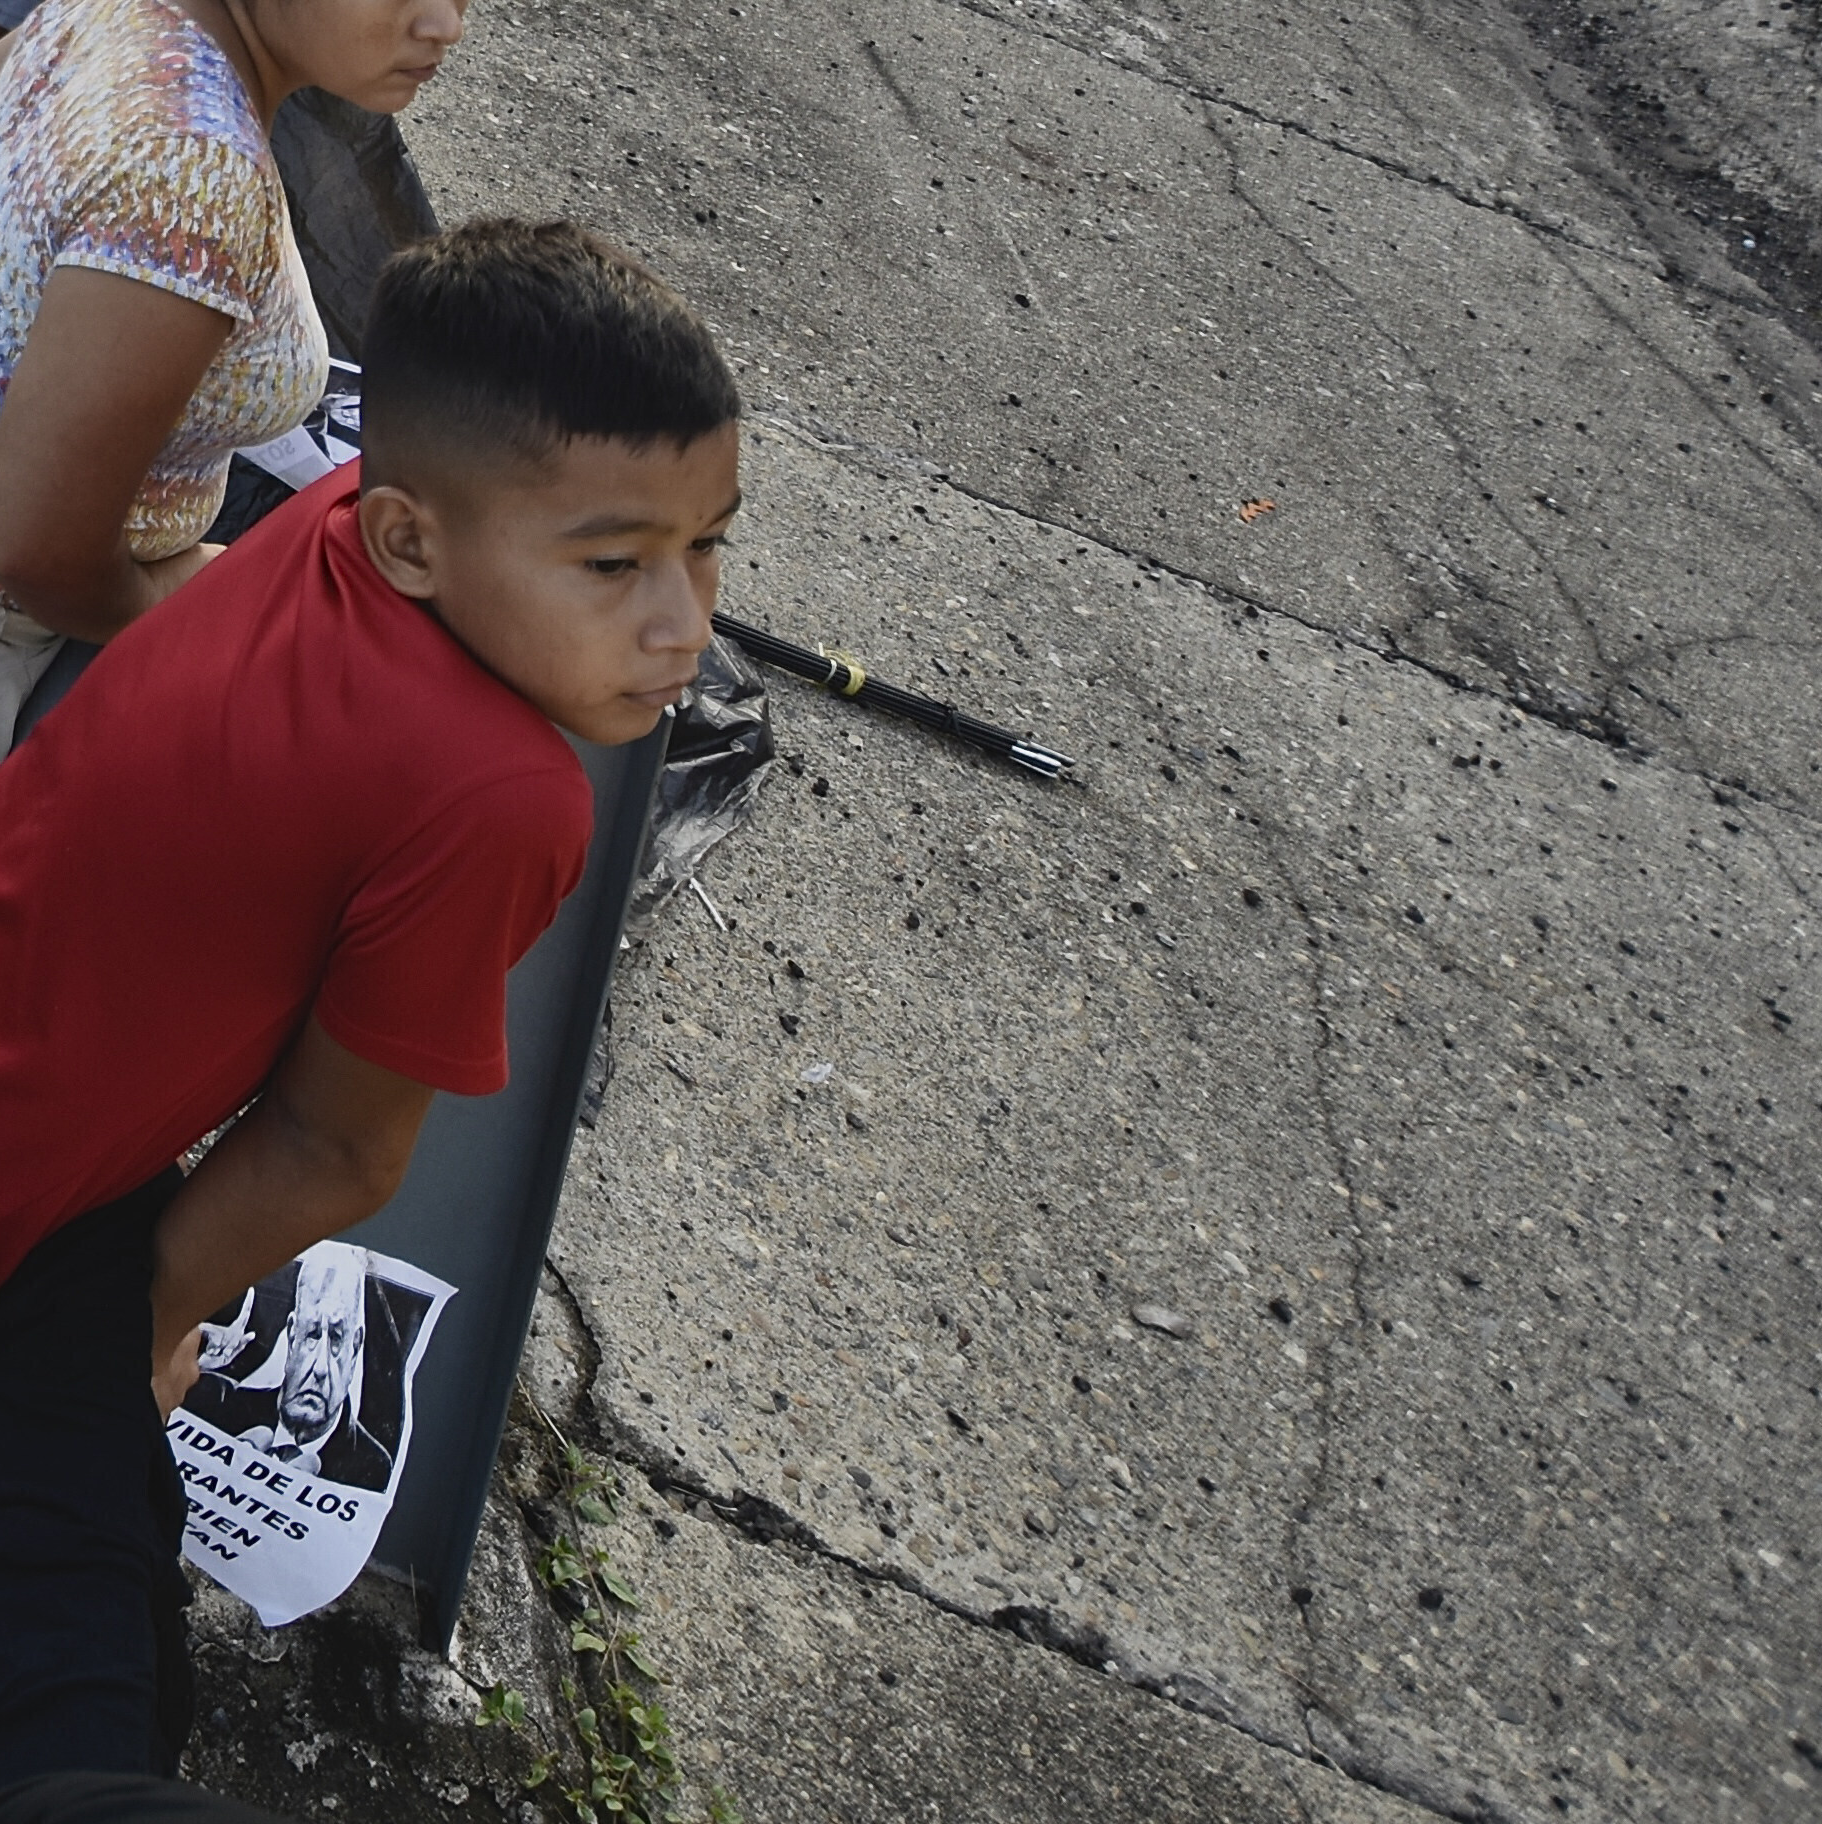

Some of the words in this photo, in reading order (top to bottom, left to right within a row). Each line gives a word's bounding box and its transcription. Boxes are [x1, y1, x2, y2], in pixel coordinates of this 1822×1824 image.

[177, 1459, 311, 1541] RANTES
[186, 1497, 262, 1548] BIEN
[243, 1460, 293, 1495] DE
[295, 1485, 359, 1523] LOS
